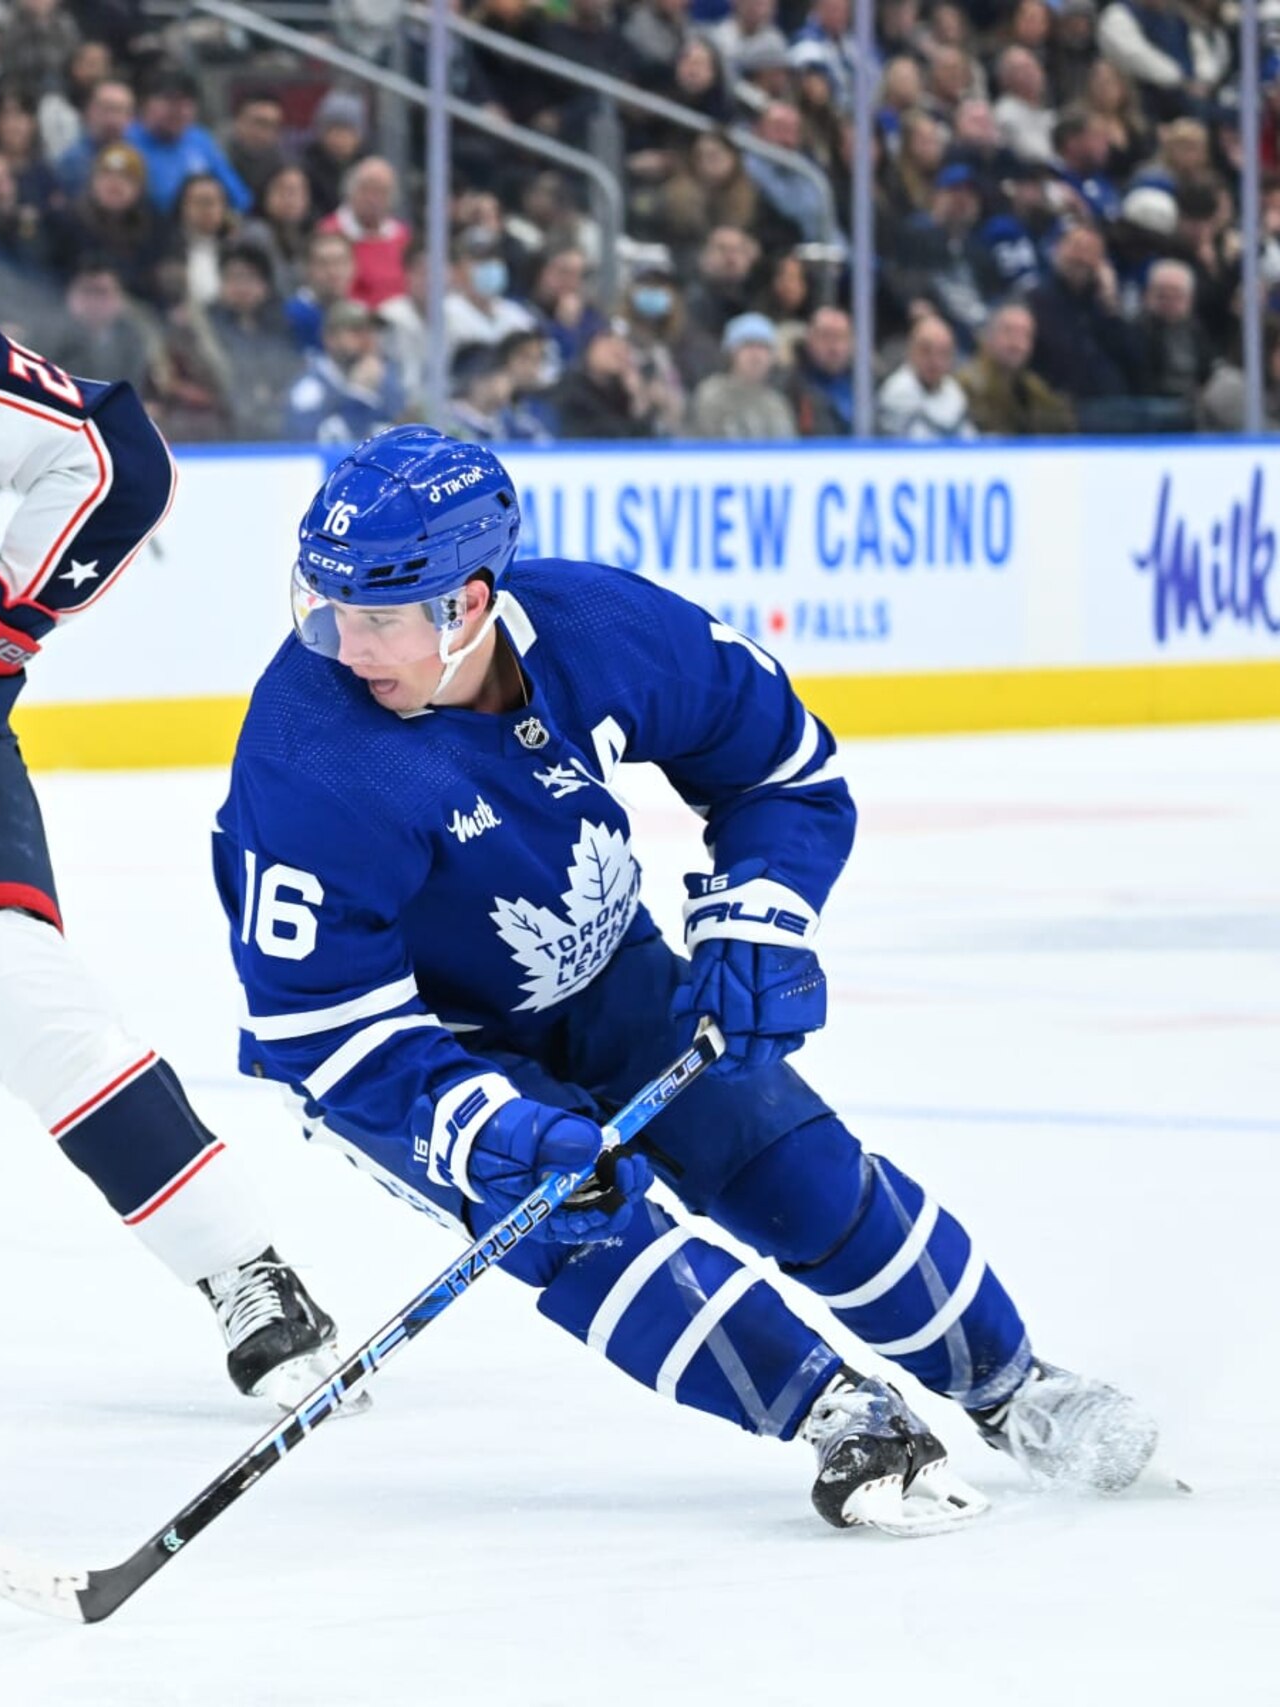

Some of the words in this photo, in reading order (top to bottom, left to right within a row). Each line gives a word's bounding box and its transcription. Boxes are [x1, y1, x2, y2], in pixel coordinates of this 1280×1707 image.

[322, 500, 358, 536] 16
[519, 484, 793, 572] ALLSVIEW
[815, 480, 1015, 568] CASINO
[308, 552, 354, 575] CCM
[793, 602, 891, 641] FALLS
[700, 873, 730, 893] 16
[240, 849, 325, 961] 16
[535, 882, 635, 960] TORON
